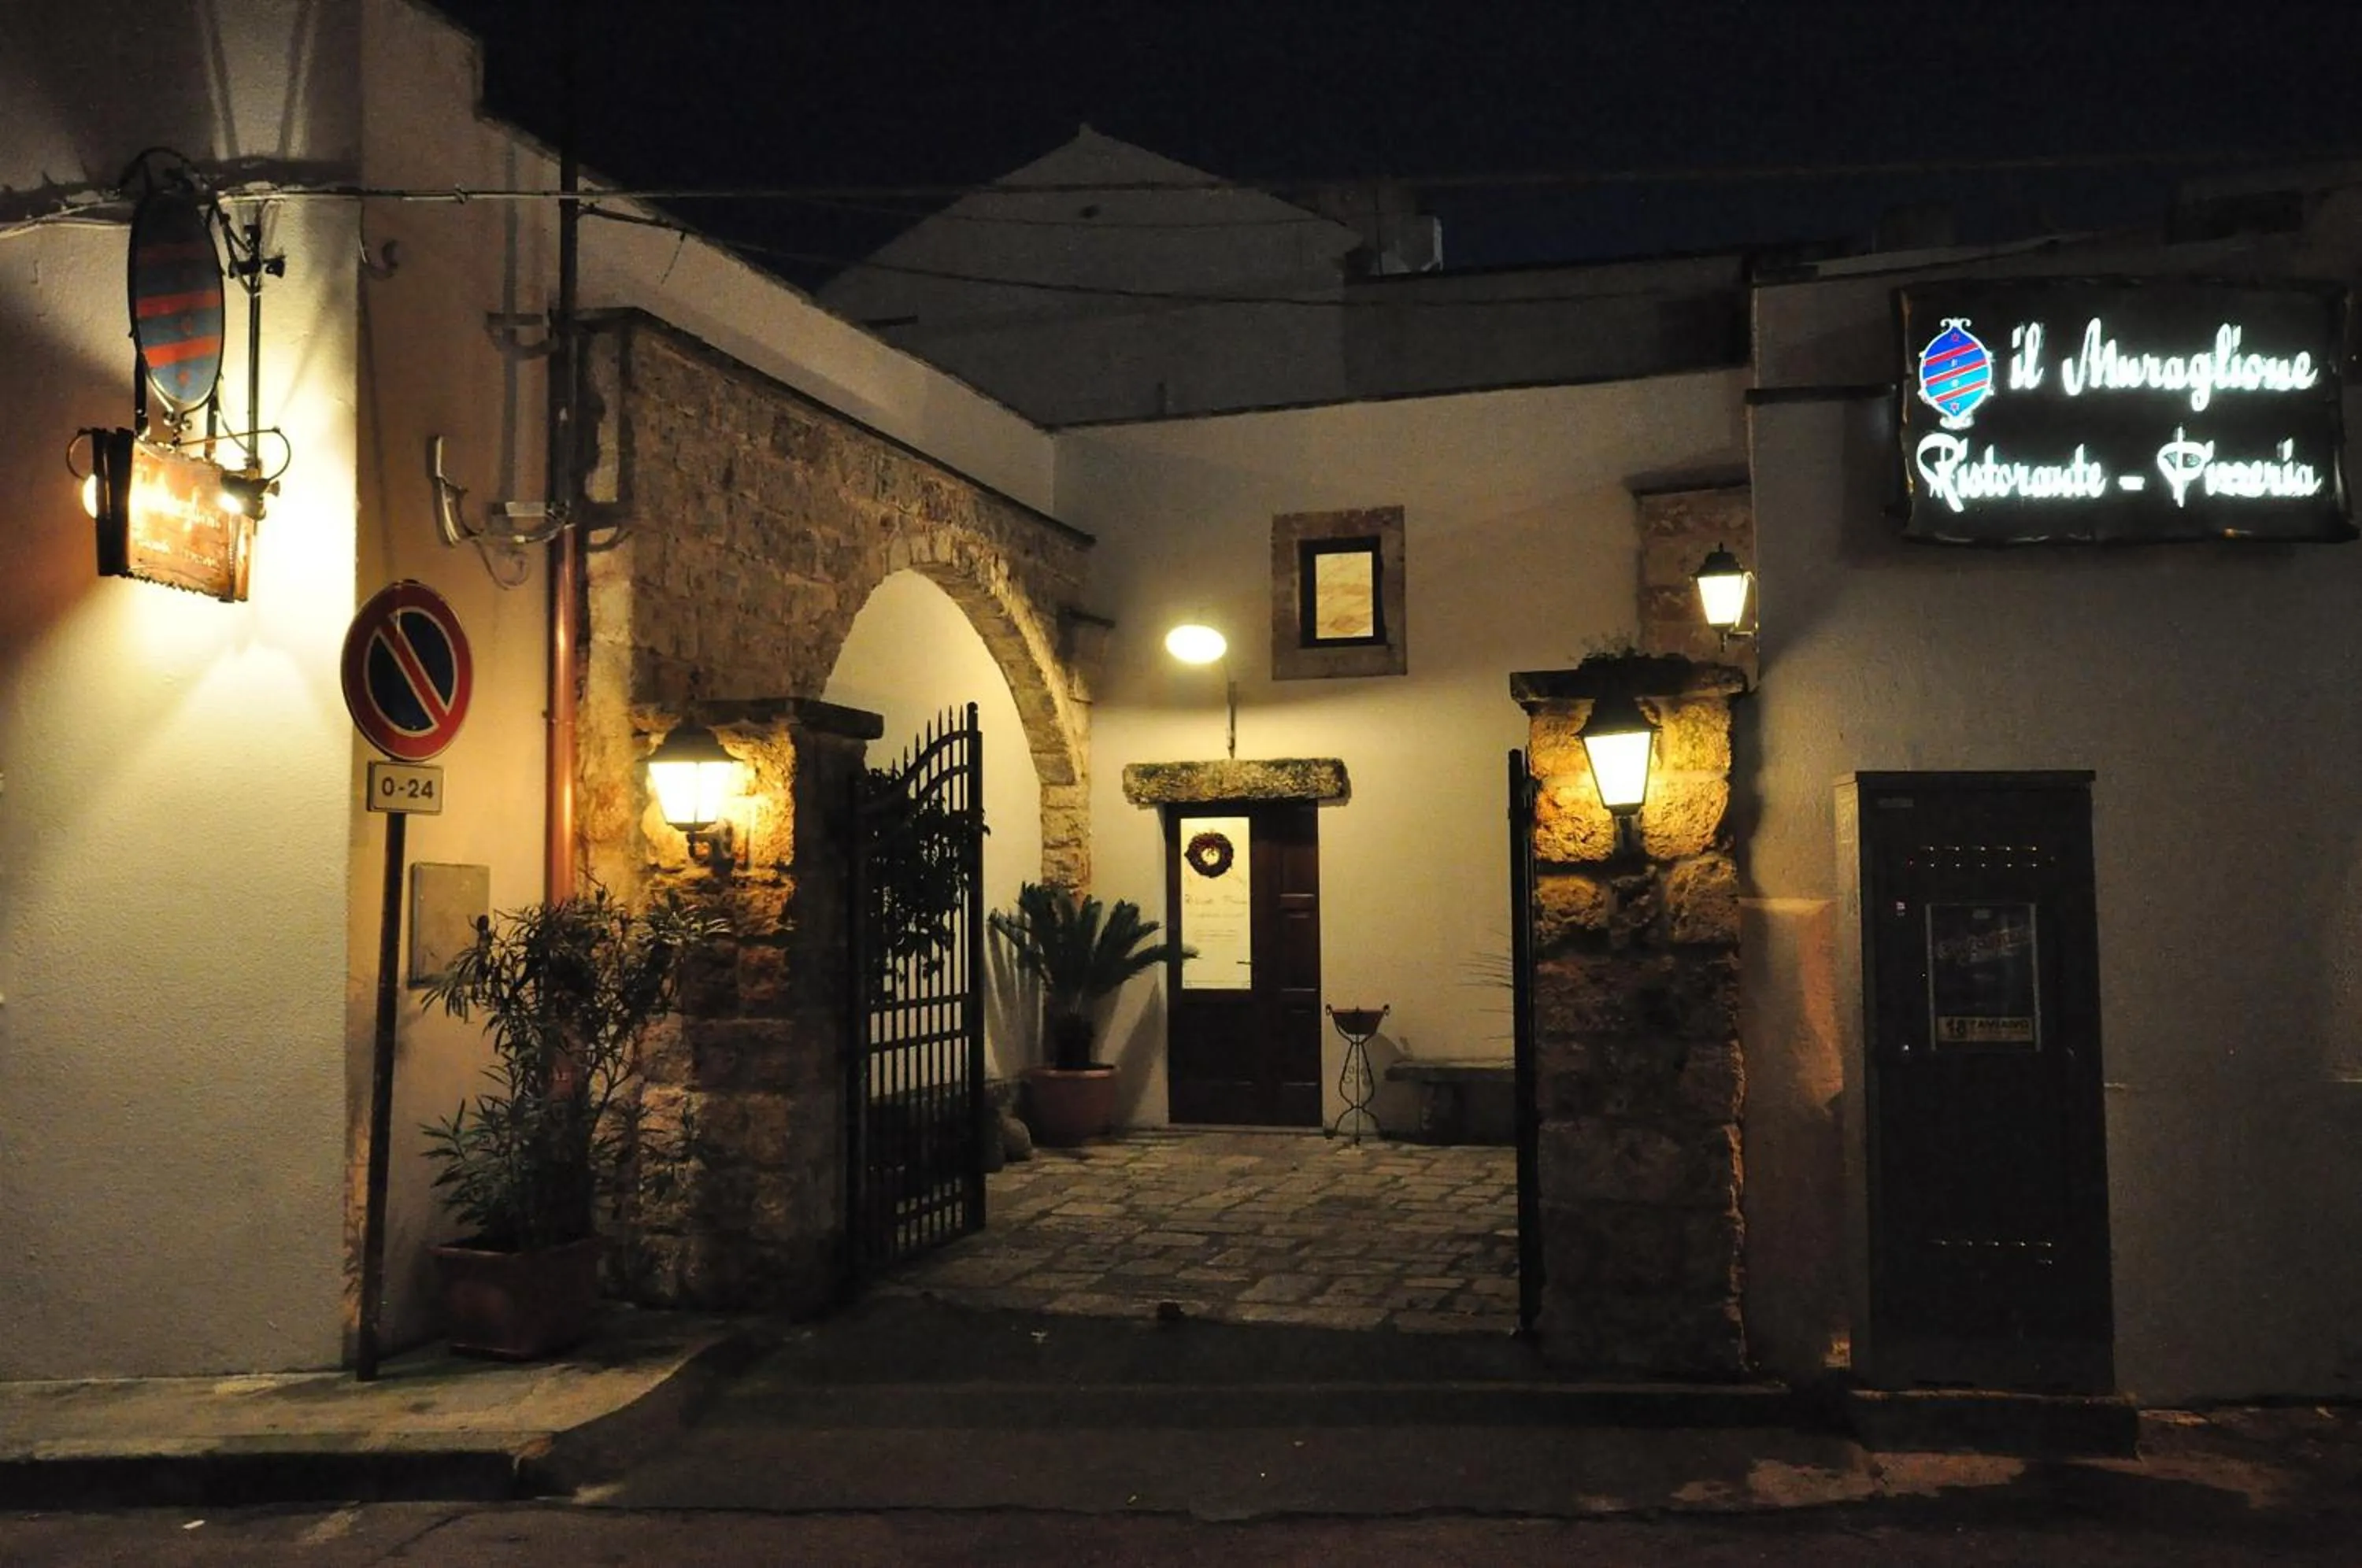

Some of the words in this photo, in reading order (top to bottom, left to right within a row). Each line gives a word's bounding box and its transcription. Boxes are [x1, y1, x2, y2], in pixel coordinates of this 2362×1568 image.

[2008, 321, 2045, 390] il
[2060, 316, 2319, 412] Muraglione
[1916, 432, 2107, 513] Ristorante
[381, 776, 434, 799] 0-24
